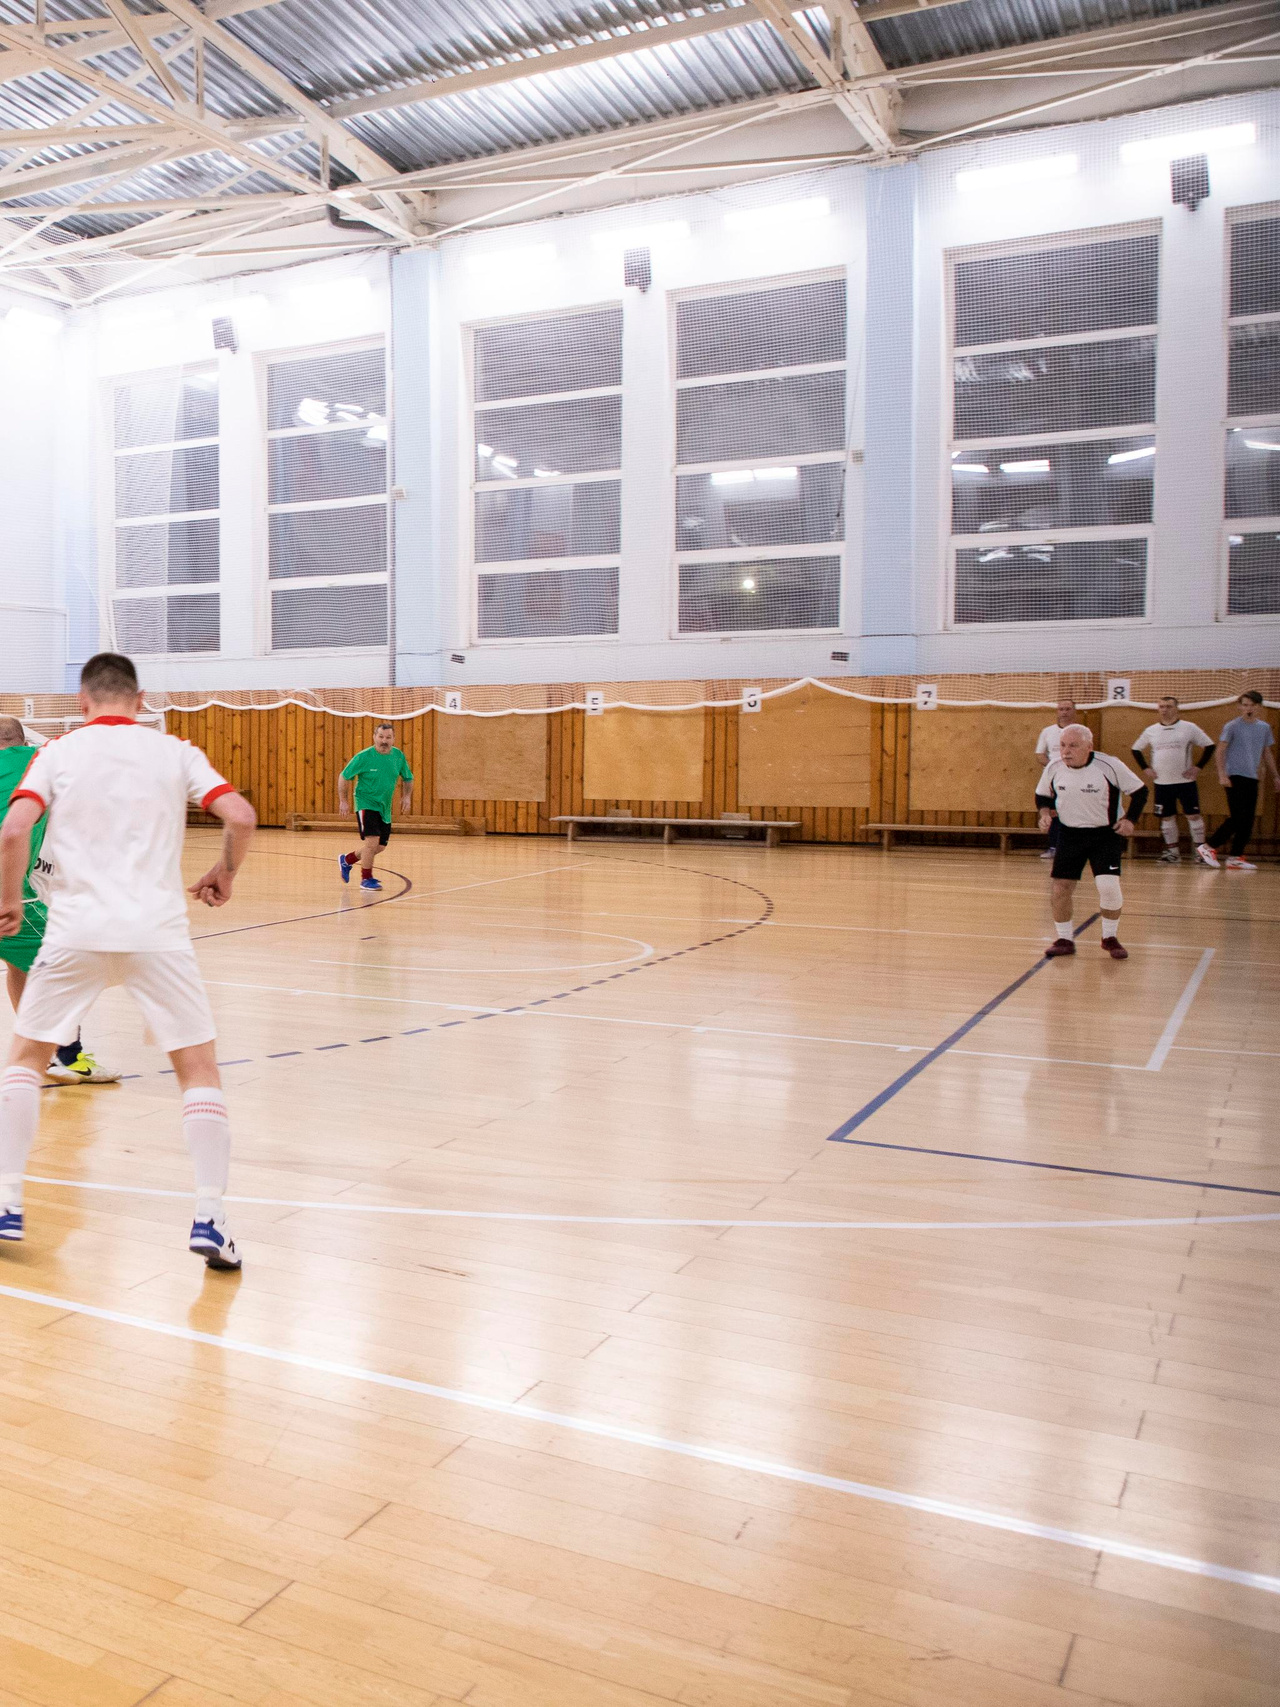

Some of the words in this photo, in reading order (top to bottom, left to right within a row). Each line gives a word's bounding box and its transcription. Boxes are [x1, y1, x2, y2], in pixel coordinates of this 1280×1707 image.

[921, 690, 932, 706] 7
[1113, 686, 1125, 700] 8
[449, 697, 458, 710] 4
